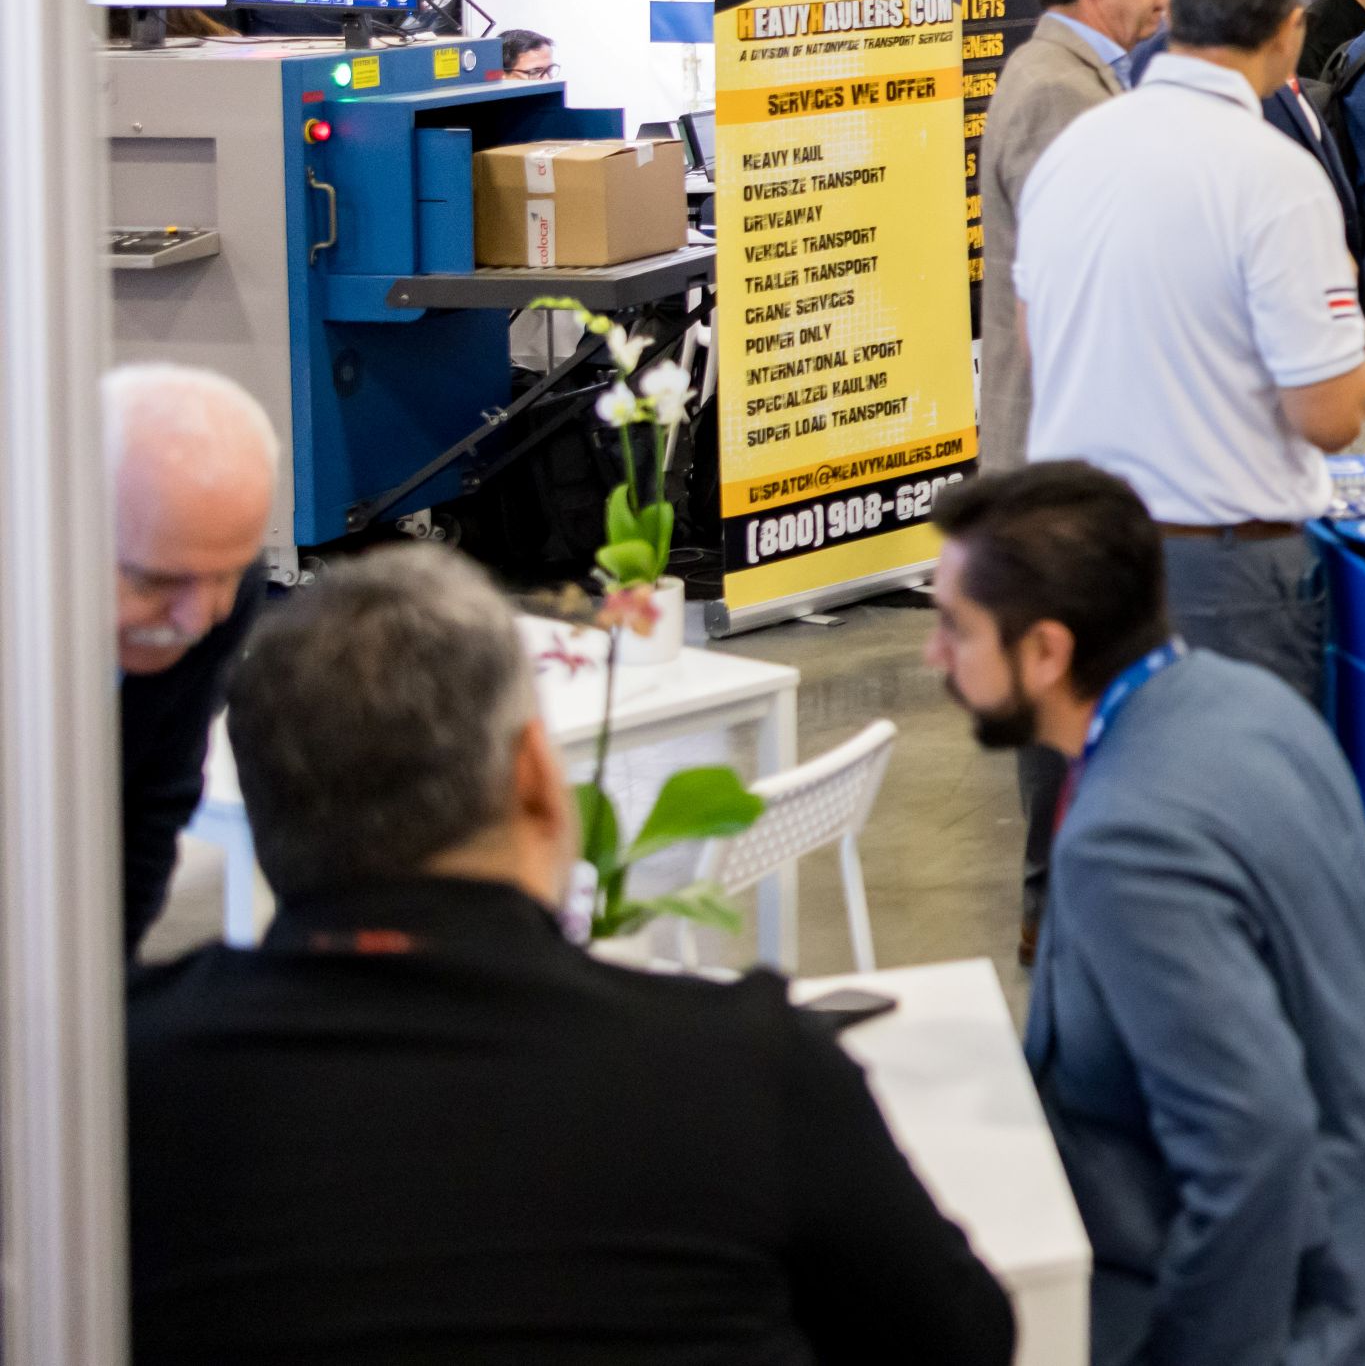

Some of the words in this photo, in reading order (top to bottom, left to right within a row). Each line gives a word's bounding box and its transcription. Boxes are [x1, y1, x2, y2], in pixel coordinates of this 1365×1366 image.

[740, 50, 747, 61] A
[751, 47, 789, 61] DIVISION
[792, 46, 802, 58] OF
[805, 40, 860, 55] NATIONWIDE
[864, 35, 915, 51] TRANSPORT
[768, 86, 844, 116] SERVICES
[851, 82, 880, 105] WE
[886, 77, 936, 101] OFFER
[743, 149, 789, 171] HEAVY
[793, 145, 824, 165] HAUL
[743, 178, 806, 202] OVERSIZE
[811, 166, 886, 191] TRANSPORT
[743, 204, 823, 233] DRIVEAWAY
[537, 217, 549, 265] colocar
[744, 240, 798, 263] VEHICLE
[802, 226, 877, 254] TRANSPORT
[745, 270, 799, 294] TRAILER
[804, 256, 878, 284] TRANSPORT
[745, 301, 791, 325] CRANE
[796, 290, 855, 316] SERVICES
[746, 331, 795, 356] POWER
[799, 323, 832, 345] ONLY
[747, 350, 848, 386] INTERNATIONAL
[853, 339, 903, 364] EXPORT
[747, 384, 828, 416] SPECIALIZED
[832, 372, 887, 398] HAULING
[747, 423, 790, 447] SUPER
[795, 414, 827, 437] LOAD
[832, 397, 908, 428] TRANSPORT
[749, 438, 963, 503] DISPATCH@HEAVYHAULERS.COM
[747, 503, 825, 564] (800)
[827, 473, 964, 538] 908-62
